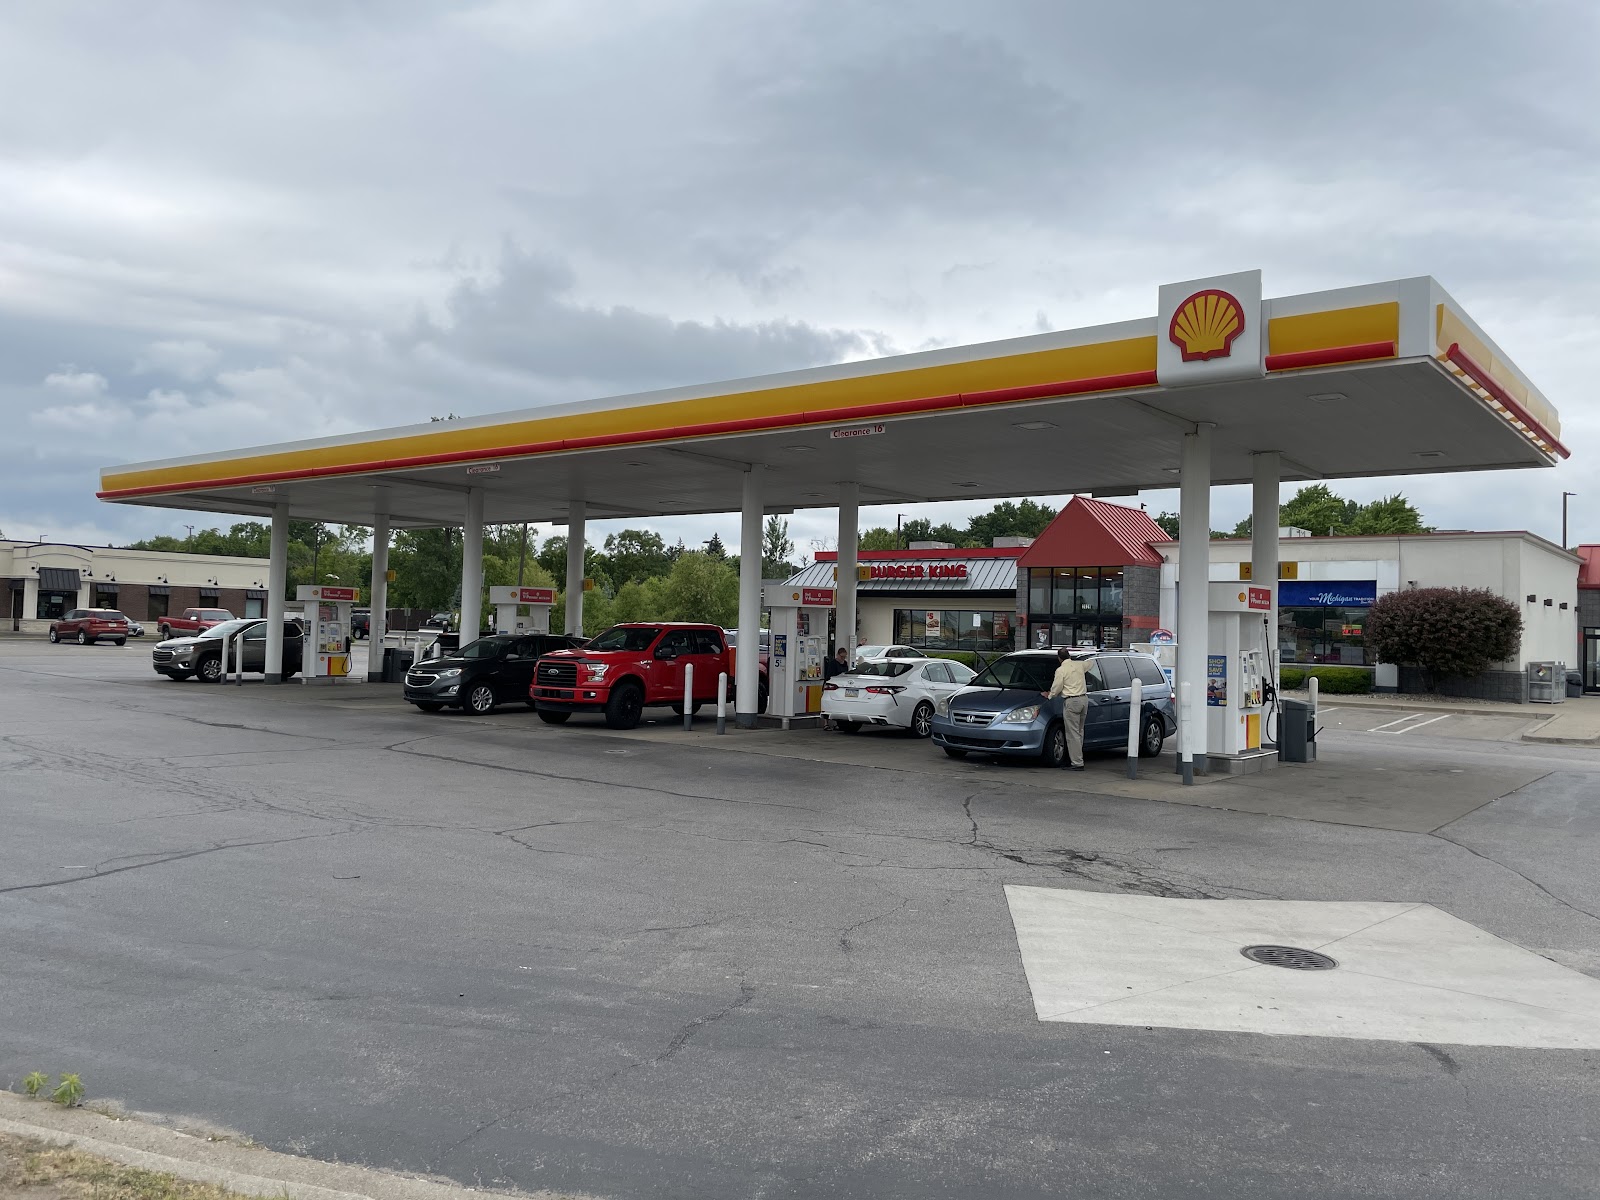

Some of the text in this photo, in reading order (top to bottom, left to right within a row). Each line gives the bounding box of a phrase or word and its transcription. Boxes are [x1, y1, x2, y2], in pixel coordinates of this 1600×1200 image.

[833, 429, 871, 438] Clearance
[870, 564, 968, 579] BURGER KING
[1318, 592, 1353, 605] Michigan
